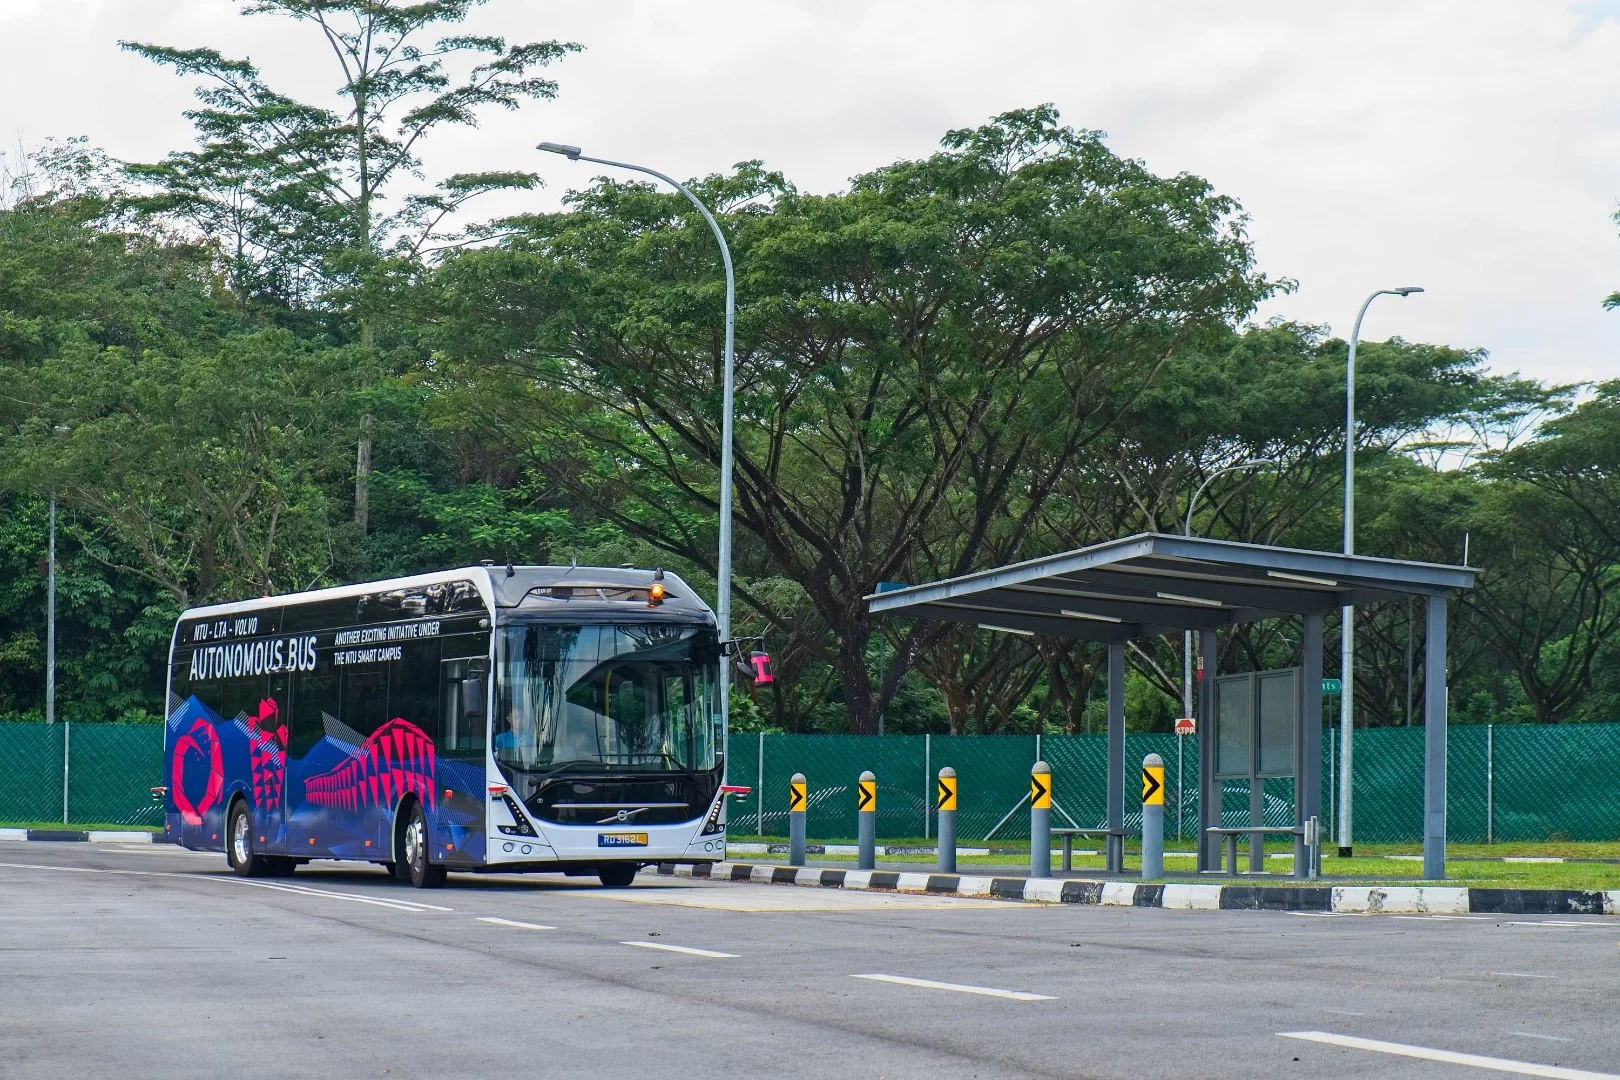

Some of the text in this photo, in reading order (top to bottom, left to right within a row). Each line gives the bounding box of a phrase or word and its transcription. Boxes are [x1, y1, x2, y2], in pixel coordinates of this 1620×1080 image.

[194, 624, 209, 640] NTU
[214, 621, 227, 639] LTA
[234, 617, 258, 636] VOLVO
[334, 621, 440, 645] ANOTHER EXCITING INITIATIVE UNDER
[189, 636, 317, 681] AUTONOMOUS BUS
[334, 646, 402, 665] THE NTU SMART CAMPUS
